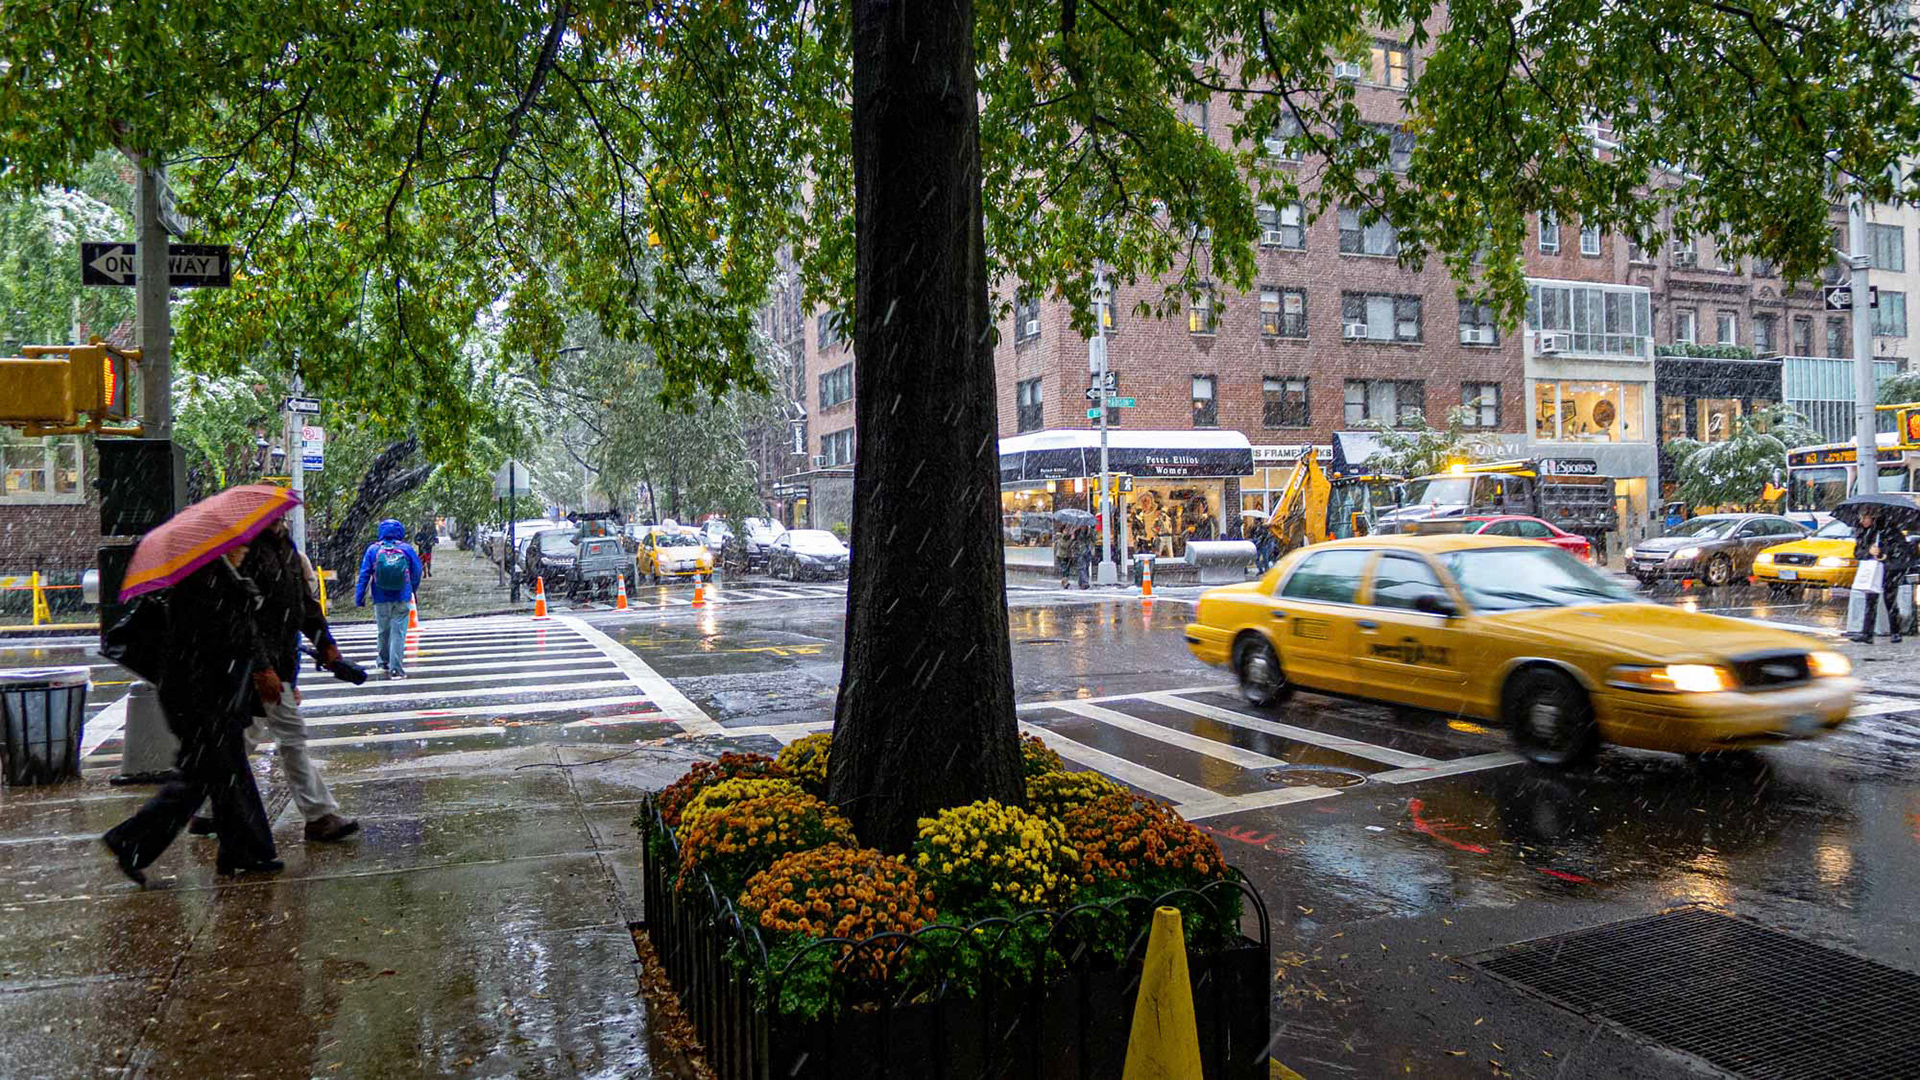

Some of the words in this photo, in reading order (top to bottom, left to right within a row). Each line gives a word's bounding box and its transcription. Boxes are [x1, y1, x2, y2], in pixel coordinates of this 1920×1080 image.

[105, 256, 134, 273] ON
[1145, 455, 1169, 465] Peter
[1173, 455, 1200, 464] Elliot
[1155, 466, 1188, 474] Women
